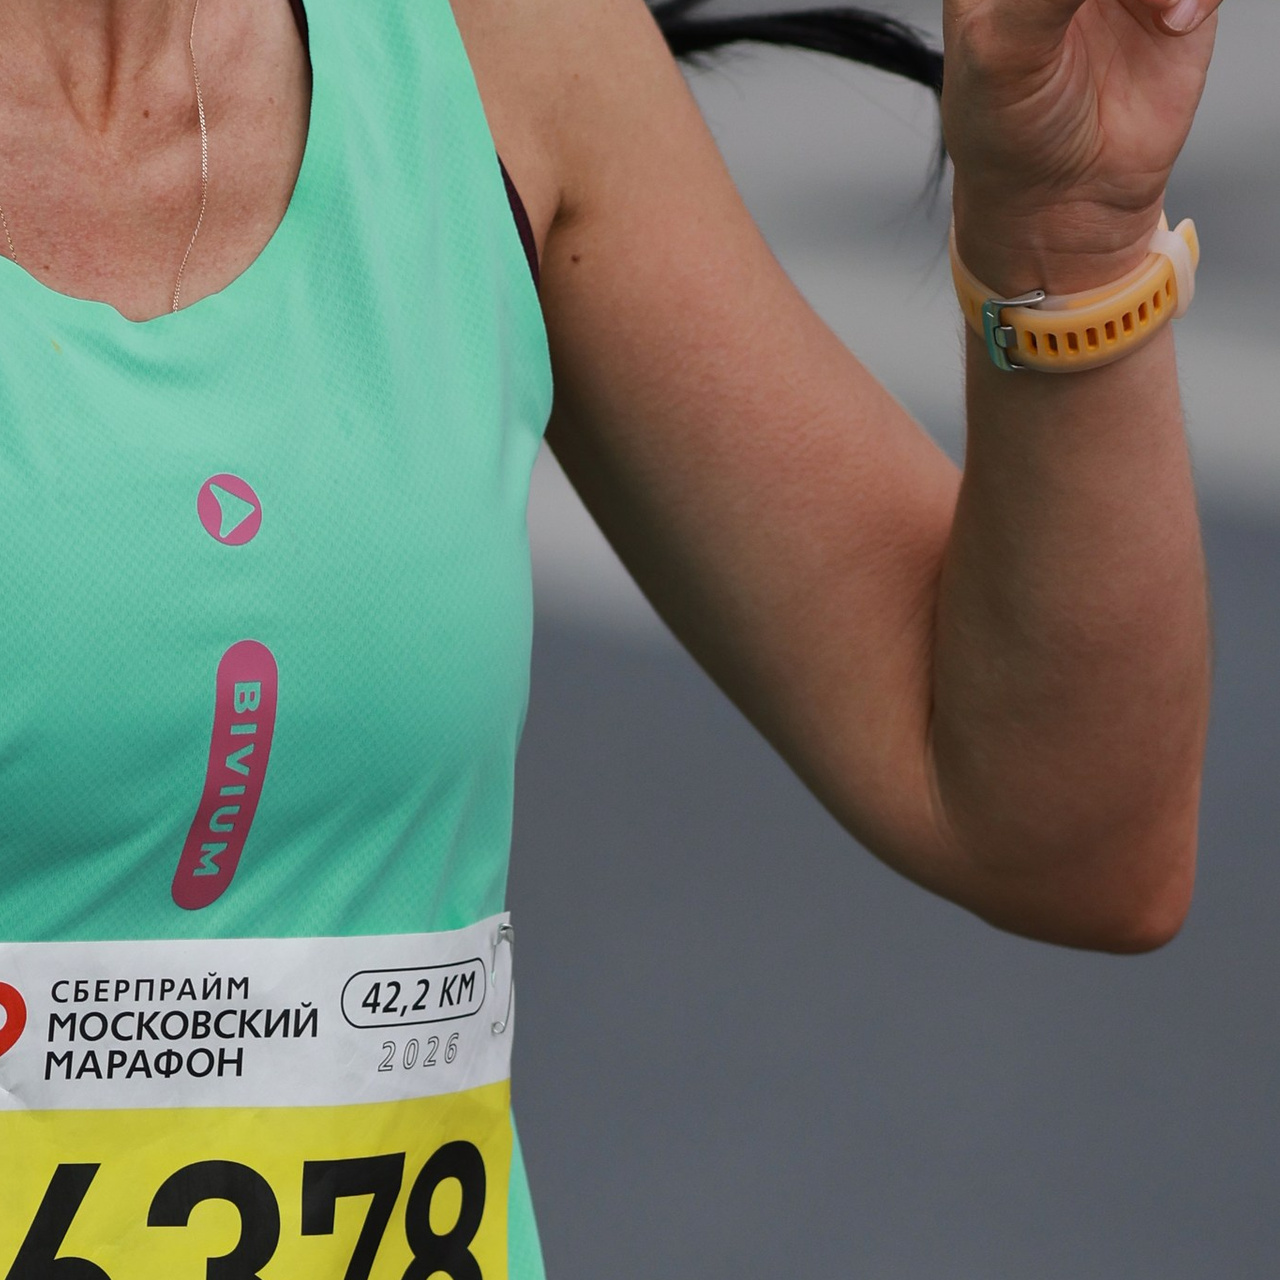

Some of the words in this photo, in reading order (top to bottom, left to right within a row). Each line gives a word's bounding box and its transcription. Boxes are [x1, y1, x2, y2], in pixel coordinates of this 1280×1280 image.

[192, 681, 262, 877] BIVIUM
[50, 972, 250, 1003] СБЕРПРАЙМ
[361, 976, 431, 1017] 42,2
[47, 1002, 319, 1042] МОСКОВСКИЙ
[43, 1046, 244, 1081] МАРАФОН
[377, 1031, 459, 1073] 2026
